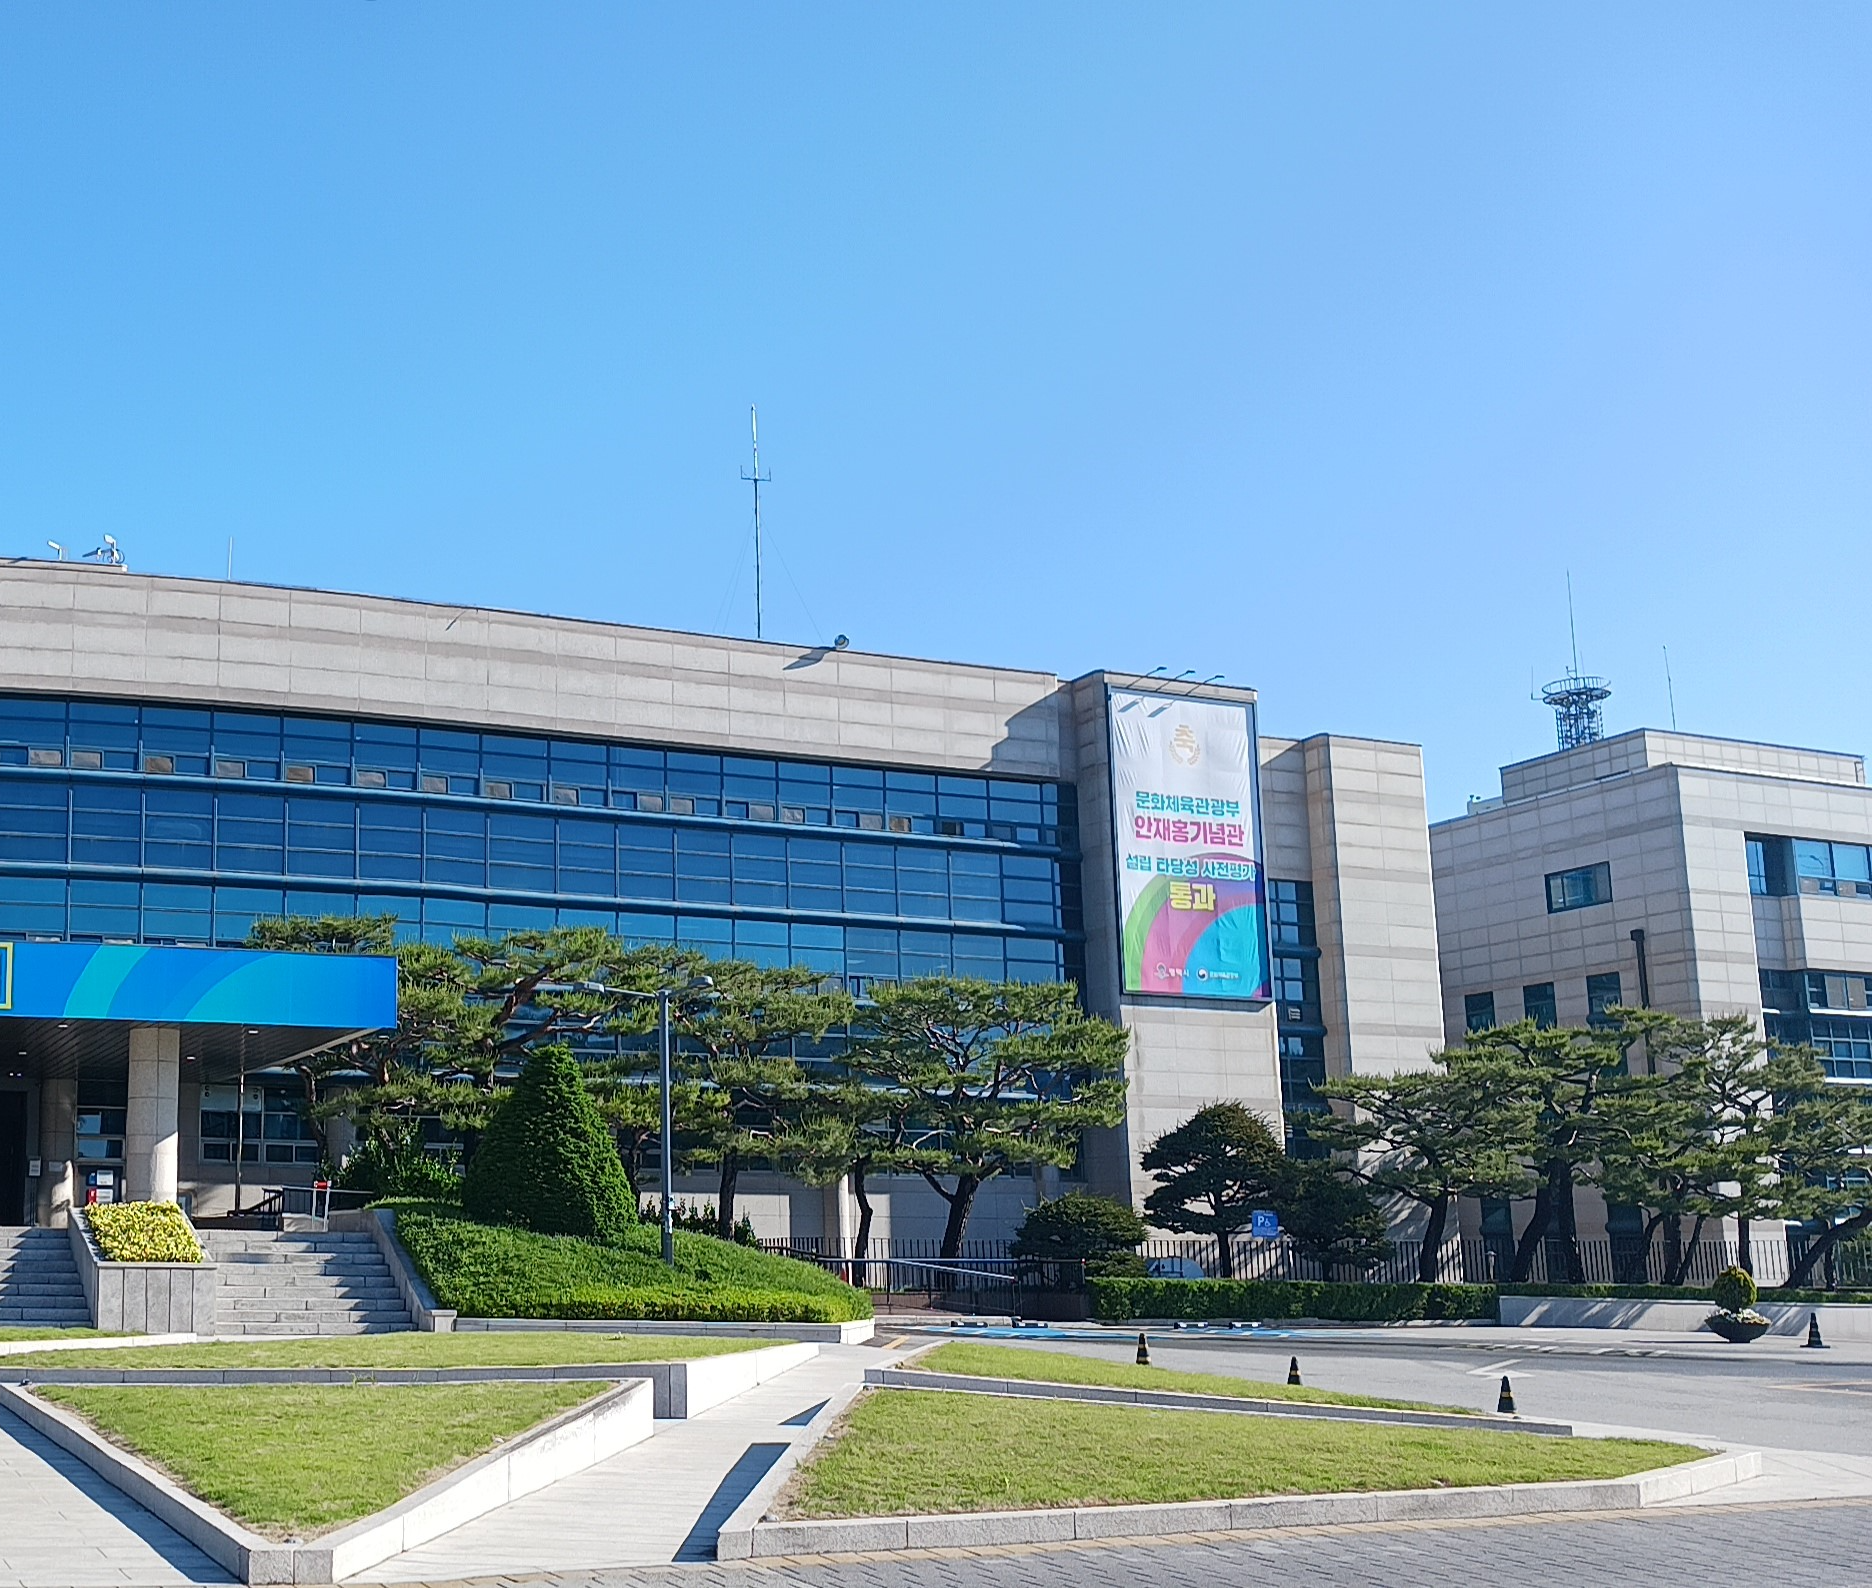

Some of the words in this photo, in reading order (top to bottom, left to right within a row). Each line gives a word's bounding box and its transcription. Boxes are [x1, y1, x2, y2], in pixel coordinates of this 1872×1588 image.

[1135, 790, 1241, 818] 문화체육관광부
[1134, 815, 1245, 848] 안재홍기념관
[1125, 852, 1152, 872] 설립
[1156, 856, 1199, 877] 타당성
[1202, 860, 1256, 882] 사전평가
[1169, 880, 1217, 912] 통과
[1258, 1216, 1264, 1226] P
